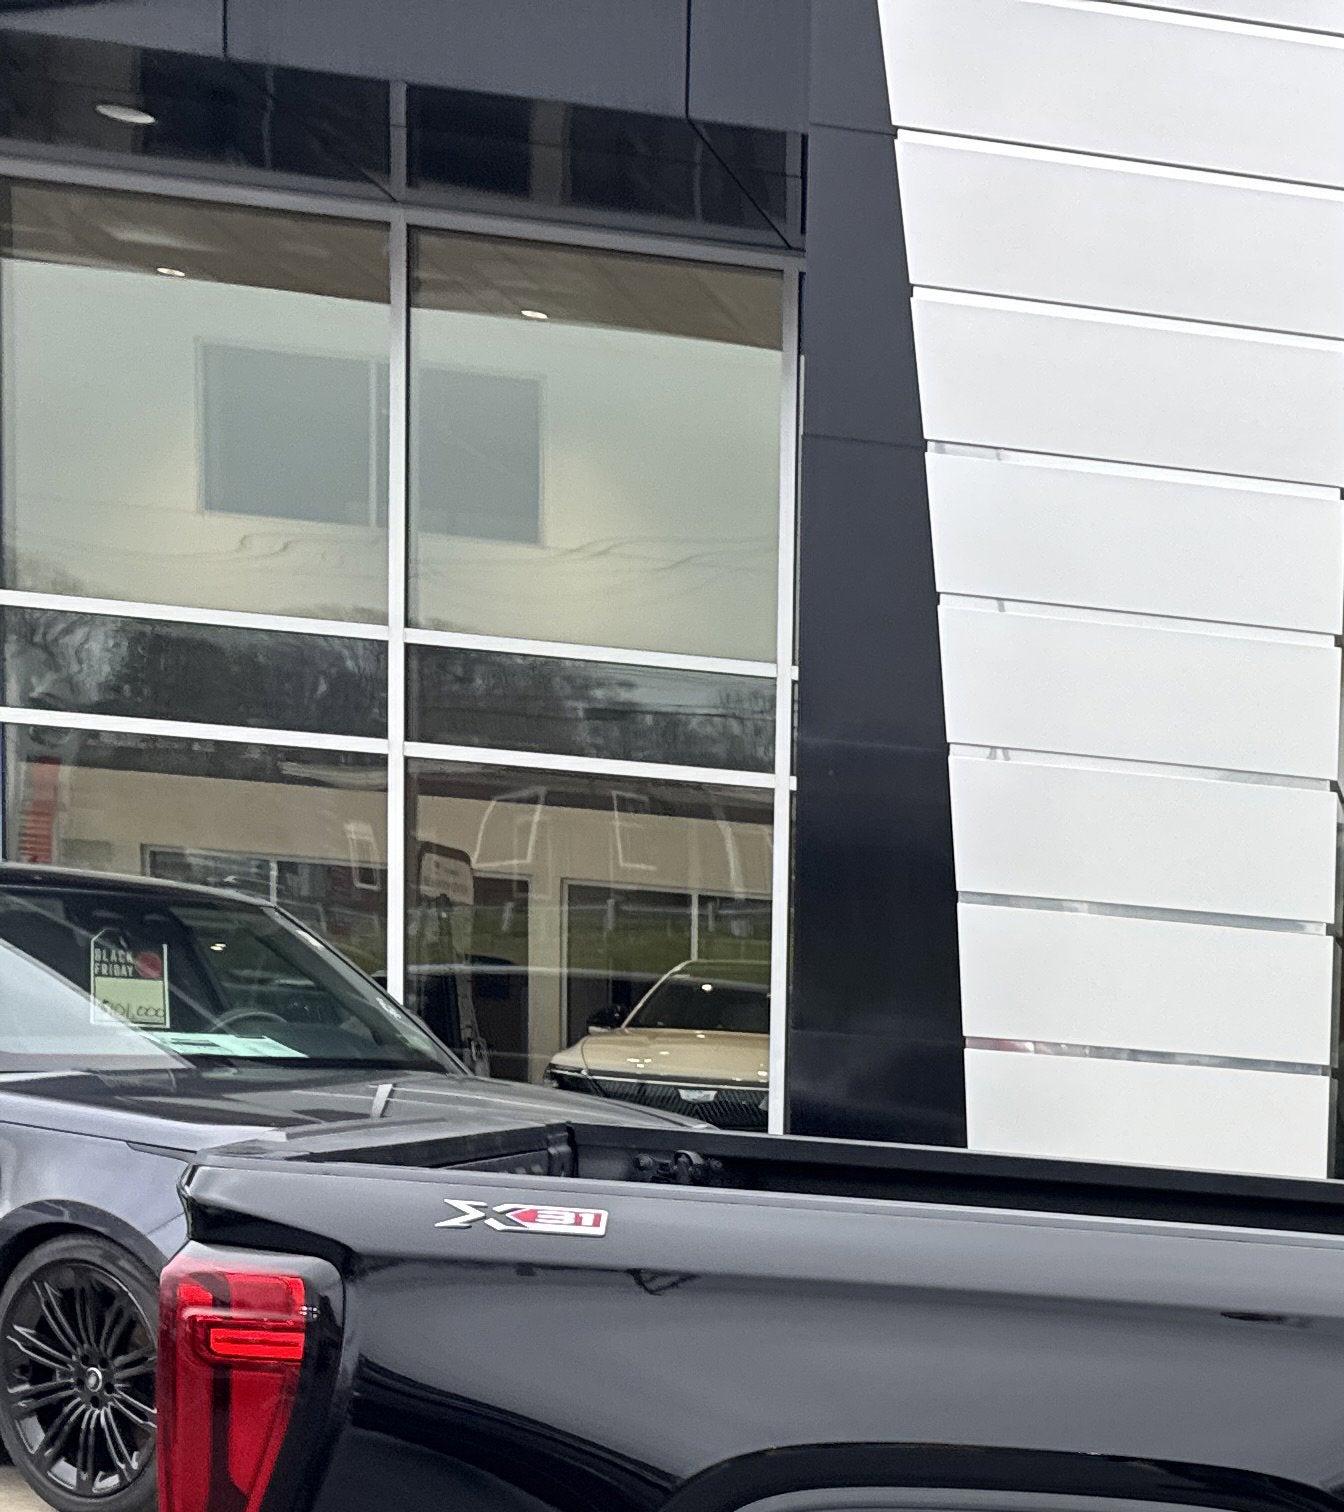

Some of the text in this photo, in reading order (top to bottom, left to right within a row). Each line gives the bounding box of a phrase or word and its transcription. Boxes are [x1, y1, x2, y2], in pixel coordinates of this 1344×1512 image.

[95, 947, 133, 964] BLACK
[95, 962, 134, 977] FRIDAY
[434, 1198, 609, 1237] X31
